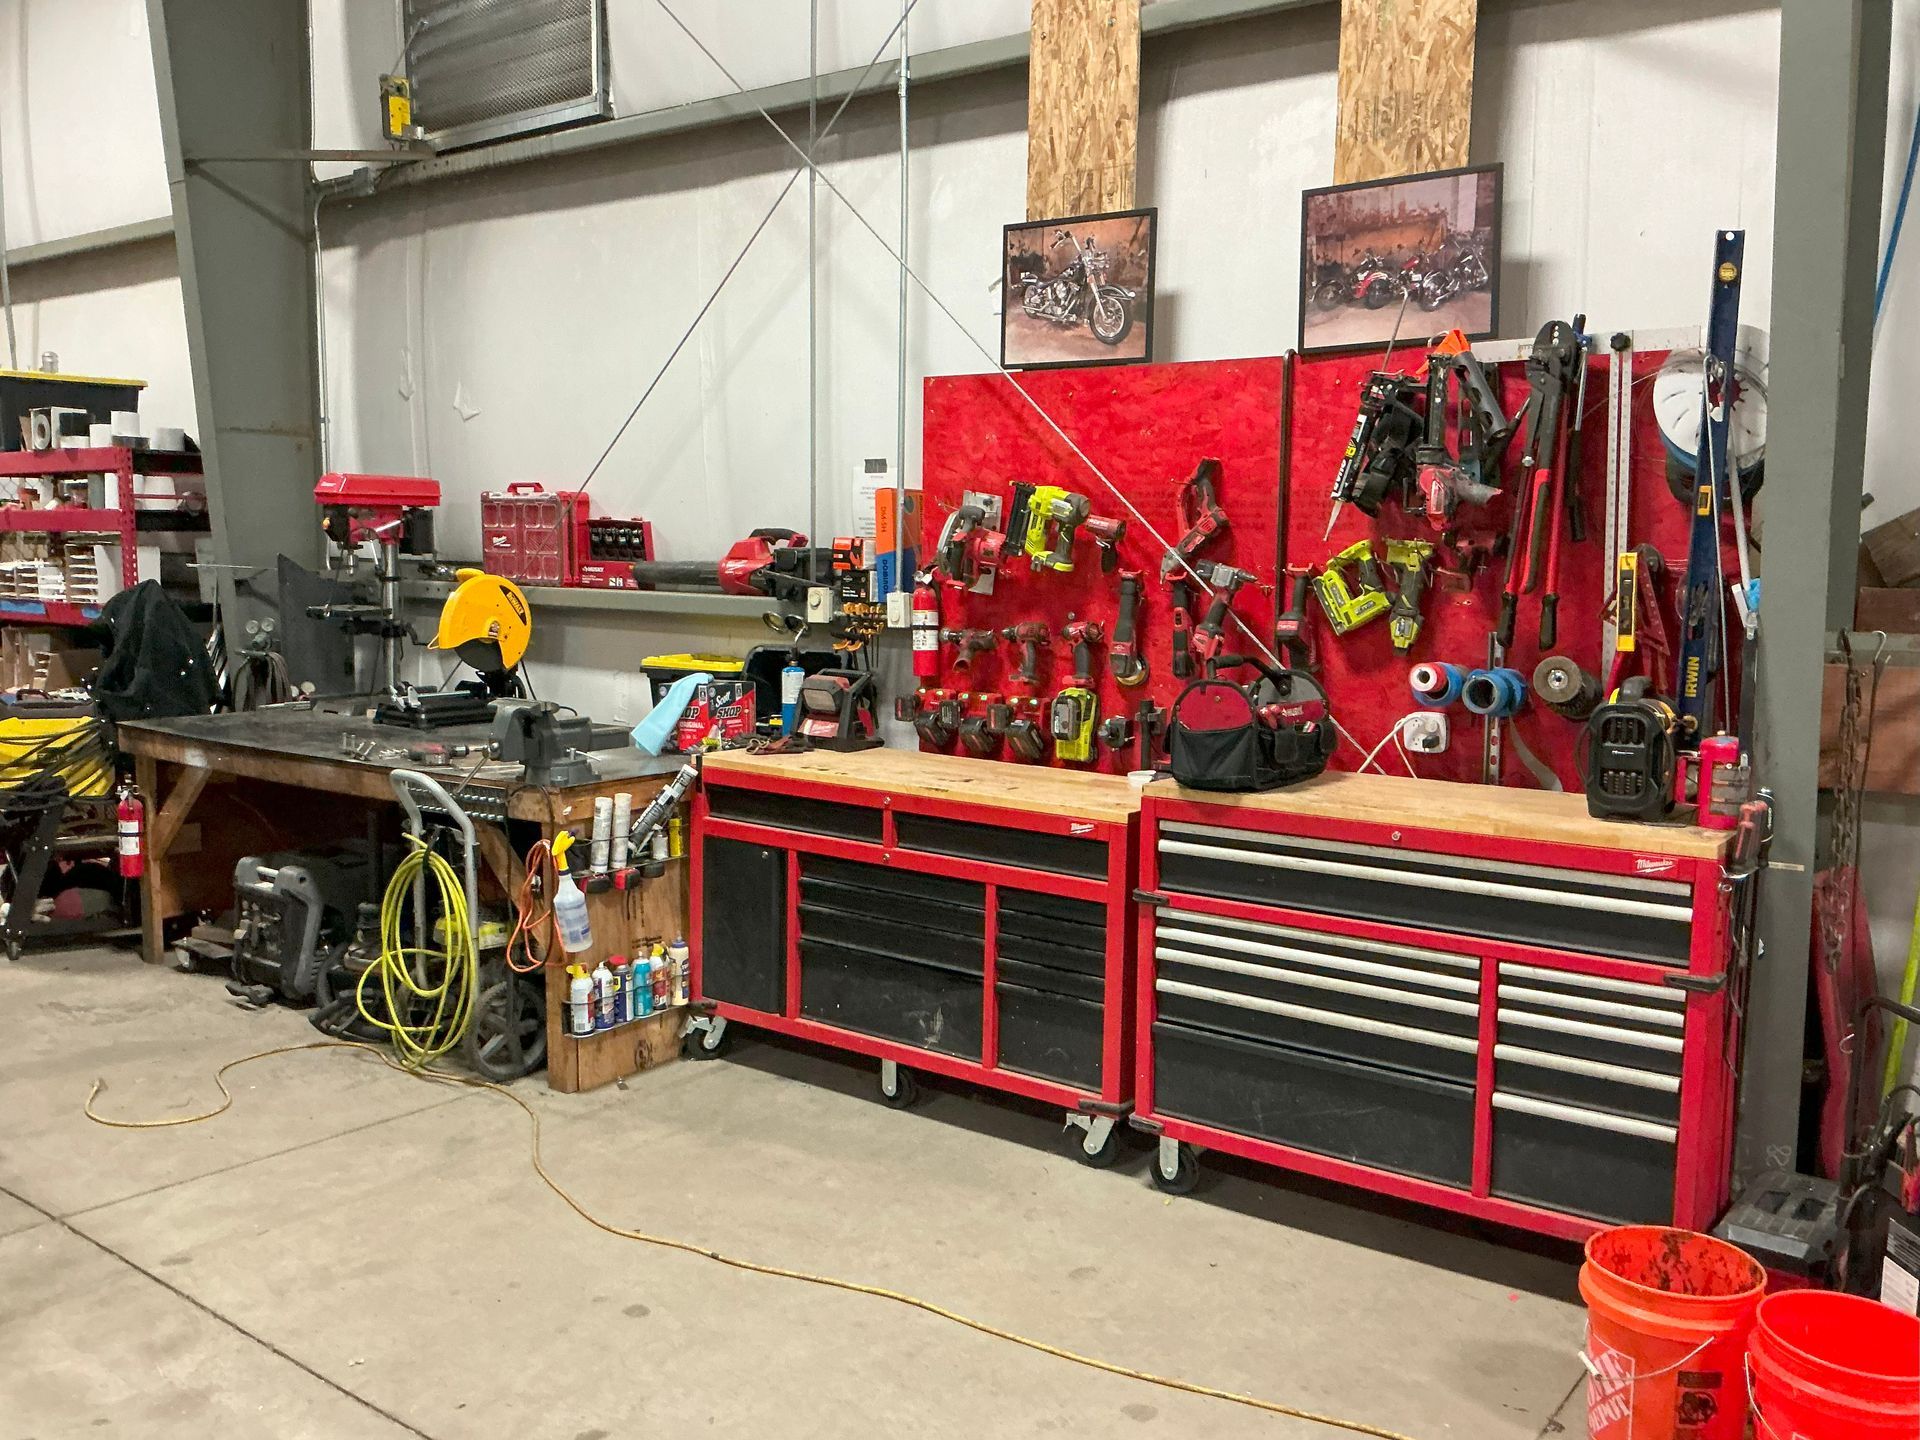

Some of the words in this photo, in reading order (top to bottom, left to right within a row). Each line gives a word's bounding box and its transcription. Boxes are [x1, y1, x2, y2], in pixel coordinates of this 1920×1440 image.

[1685, 656, 1700, 697] IRWIN
[680, 706, 700, 719] OP
[716, 706, 742, 719] SHOP
[1635, 859, 1673, 870] Milwaukee
[1589, 1349, 1632, 1407] OME
